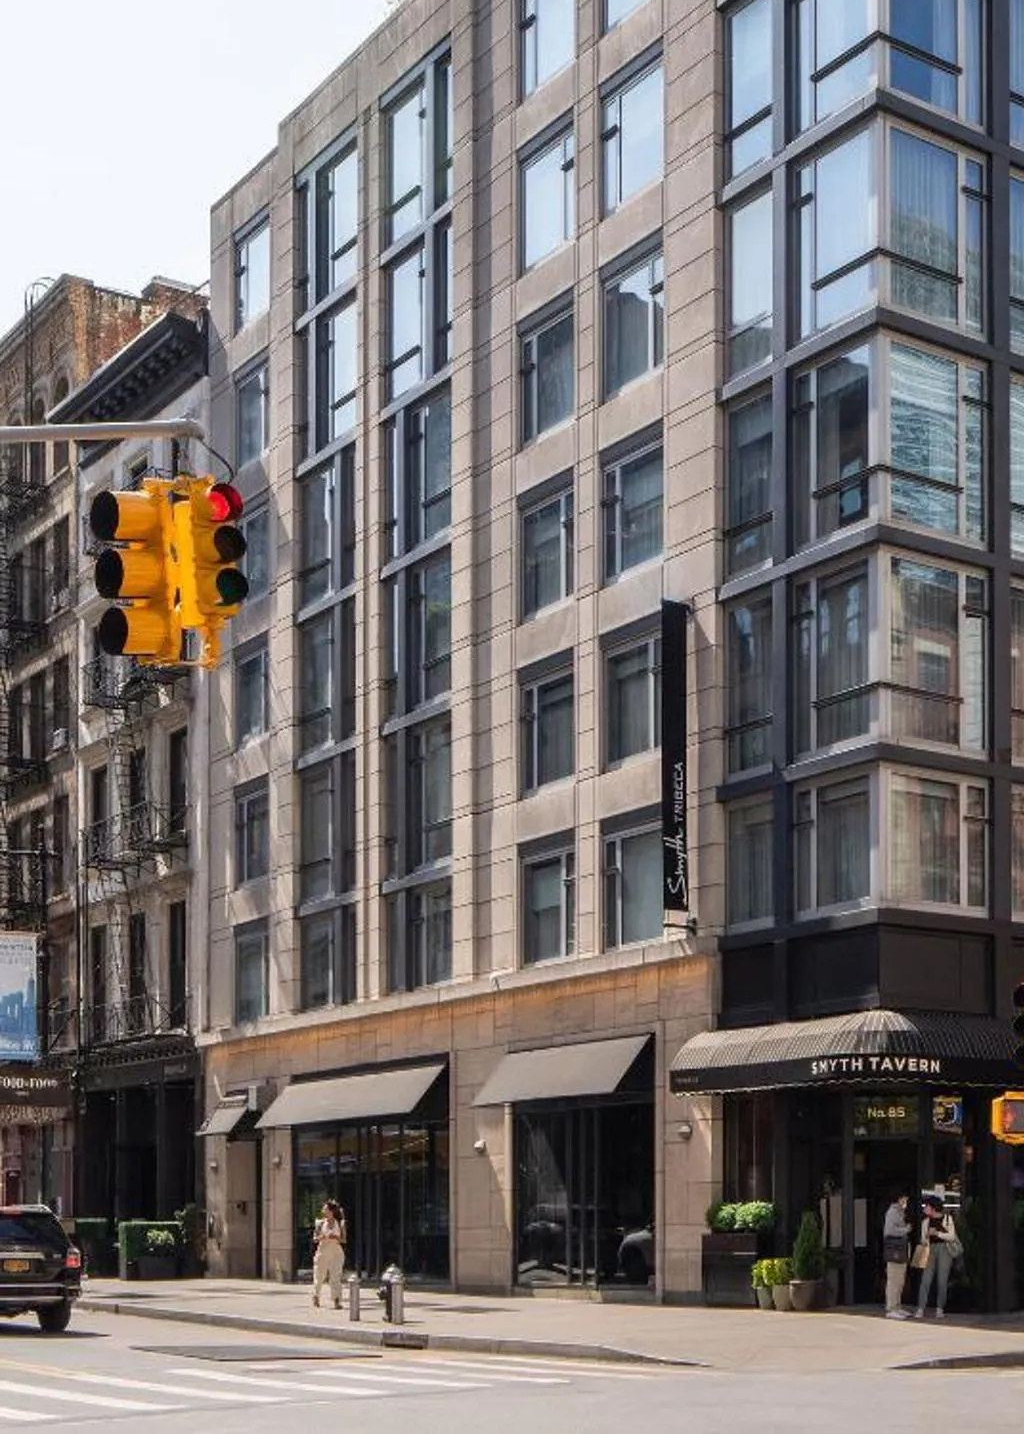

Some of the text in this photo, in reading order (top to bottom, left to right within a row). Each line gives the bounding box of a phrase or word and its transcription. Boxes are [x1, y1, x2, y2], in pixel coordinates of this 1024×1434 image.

[663, 762, 687, 906] Smyth TRIBECA
[811, 1056, 941, 1075] SMYTH TAVERN
[888, 1106, 906, 1117] 85
